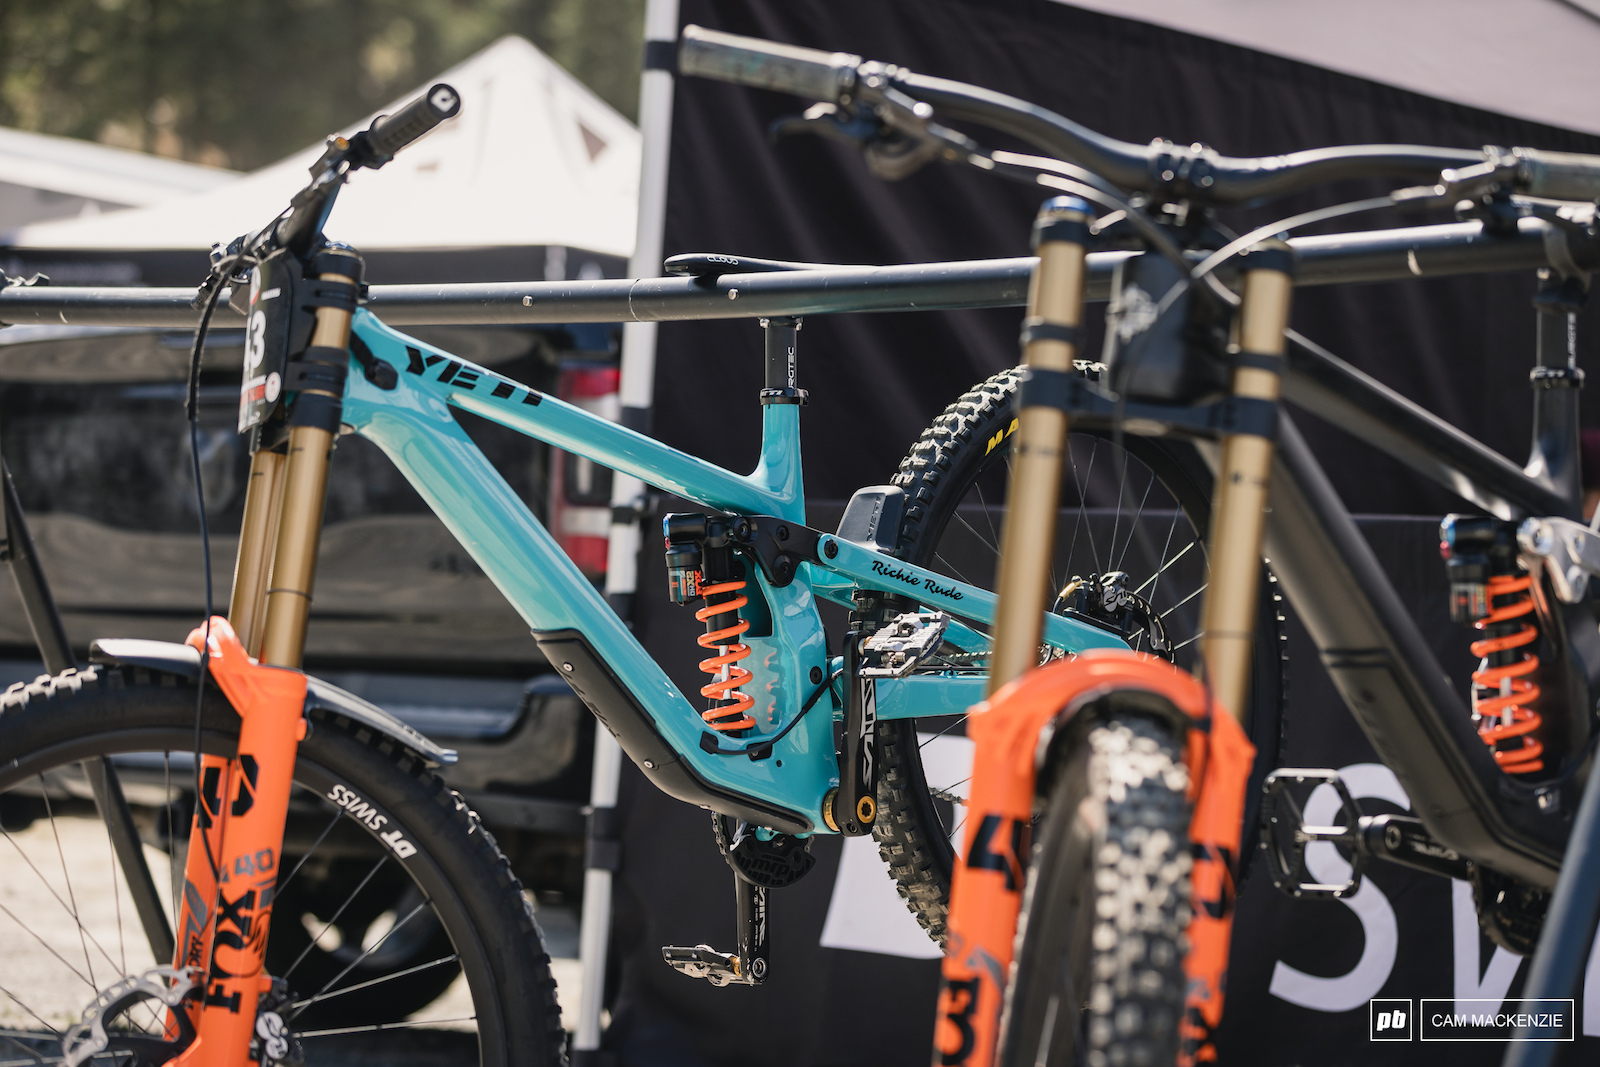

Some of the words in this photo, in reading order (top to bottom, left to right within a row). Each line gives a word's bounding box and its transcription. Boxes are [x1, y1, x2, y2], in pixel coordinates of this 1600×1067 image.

[706, 255, 739, 265] CLOUD
[405, 345, 543, 407] YETI
[787, 346, 795, 389] RGTEC
[871, 559, 921, 587] Richie
[924, 578, 964, 601] Rude
[326, 783, 389, 832] SWISS
[379, 828, 418, 860] DT
[203, 888, 256, 1014] FOX
